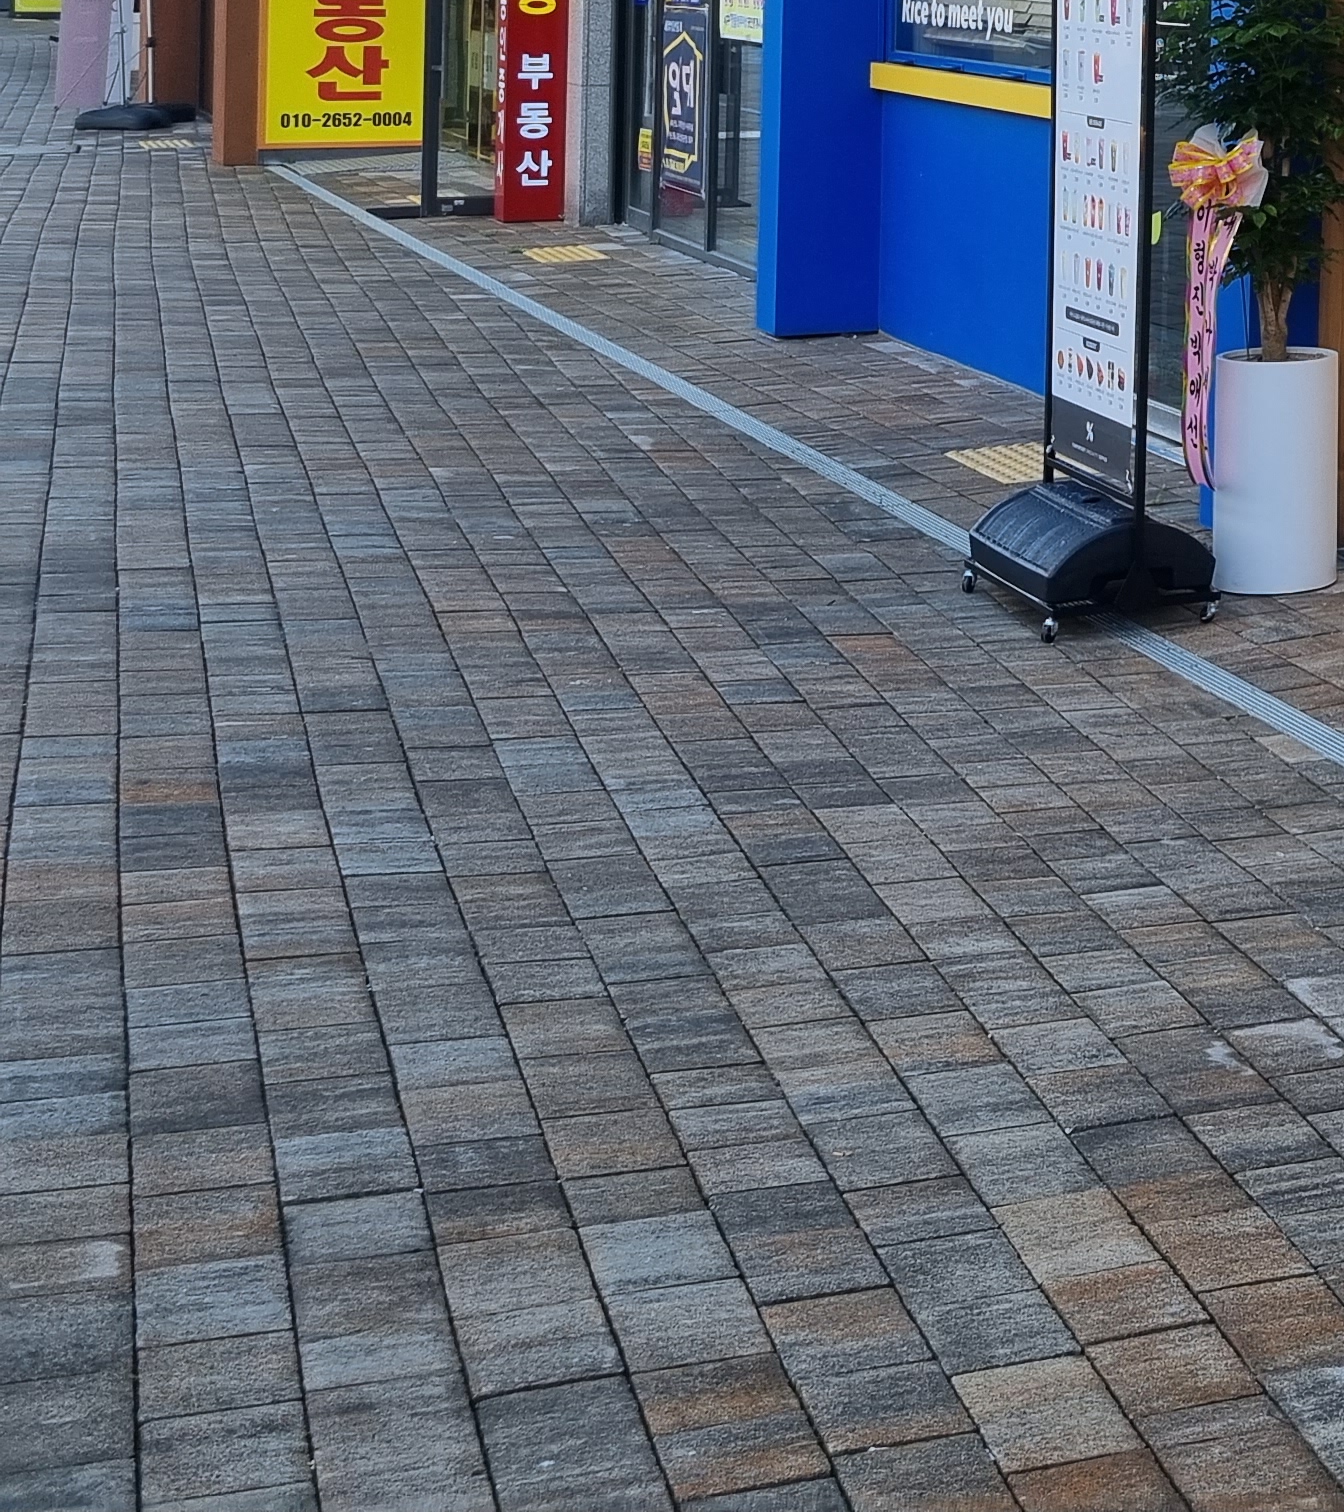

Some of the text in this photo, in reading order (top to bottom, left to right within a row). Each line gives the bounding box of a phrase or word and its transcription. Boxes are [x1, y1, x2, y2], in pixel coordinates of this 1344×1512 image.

[947, 0, 984, 31] meet
[985, 6, 1014, 41] you
[280, 111, 413, 129] 010-2652-0004
[516, 53, 554, 187] 부동산
